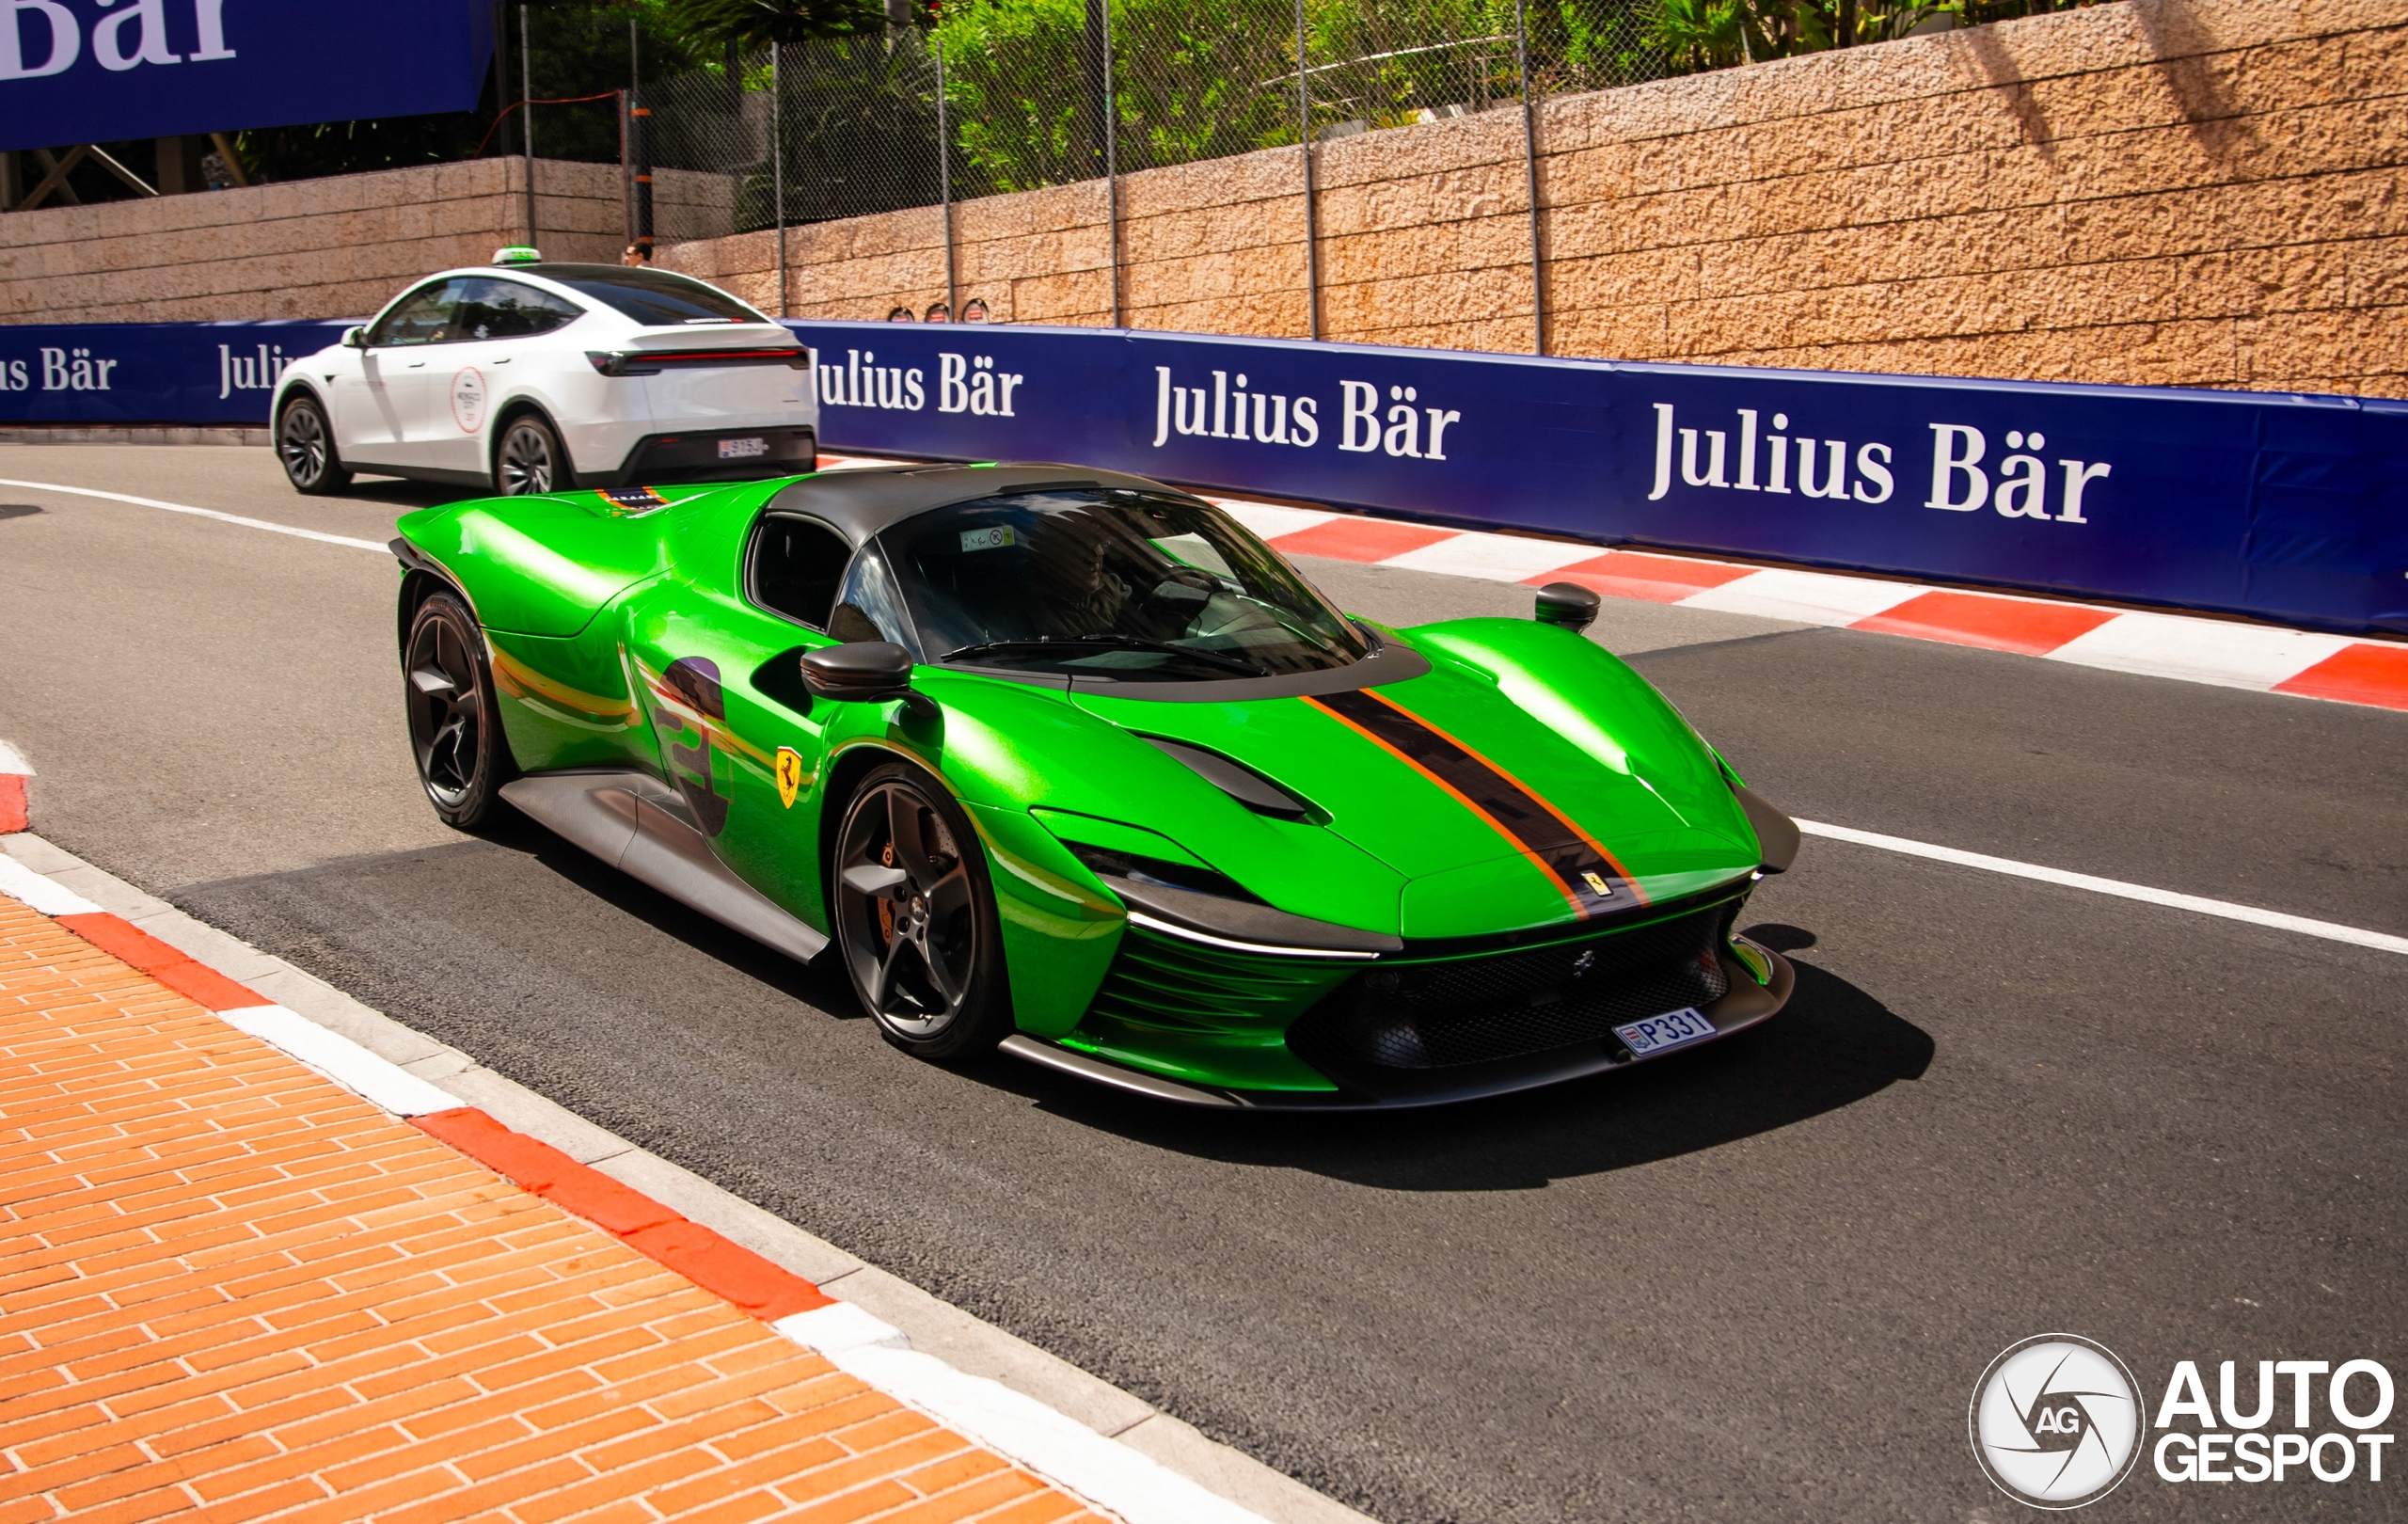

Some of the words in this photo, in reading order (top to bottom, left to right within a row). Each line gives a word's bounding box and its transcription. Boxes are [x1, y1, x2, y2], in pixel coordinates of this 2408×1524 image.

[40, 348, 118, 390] Bär
[938, 353, 1023, 417] Bär
[1152, 366, 1319, 448] Julius
[1338, 380, 1461, 461] Bär
[1648, 403, 1894, 504] Julius
[1924, 422, 2112, 524] Bär
[1637, 1010, 1708, 1045] P331
